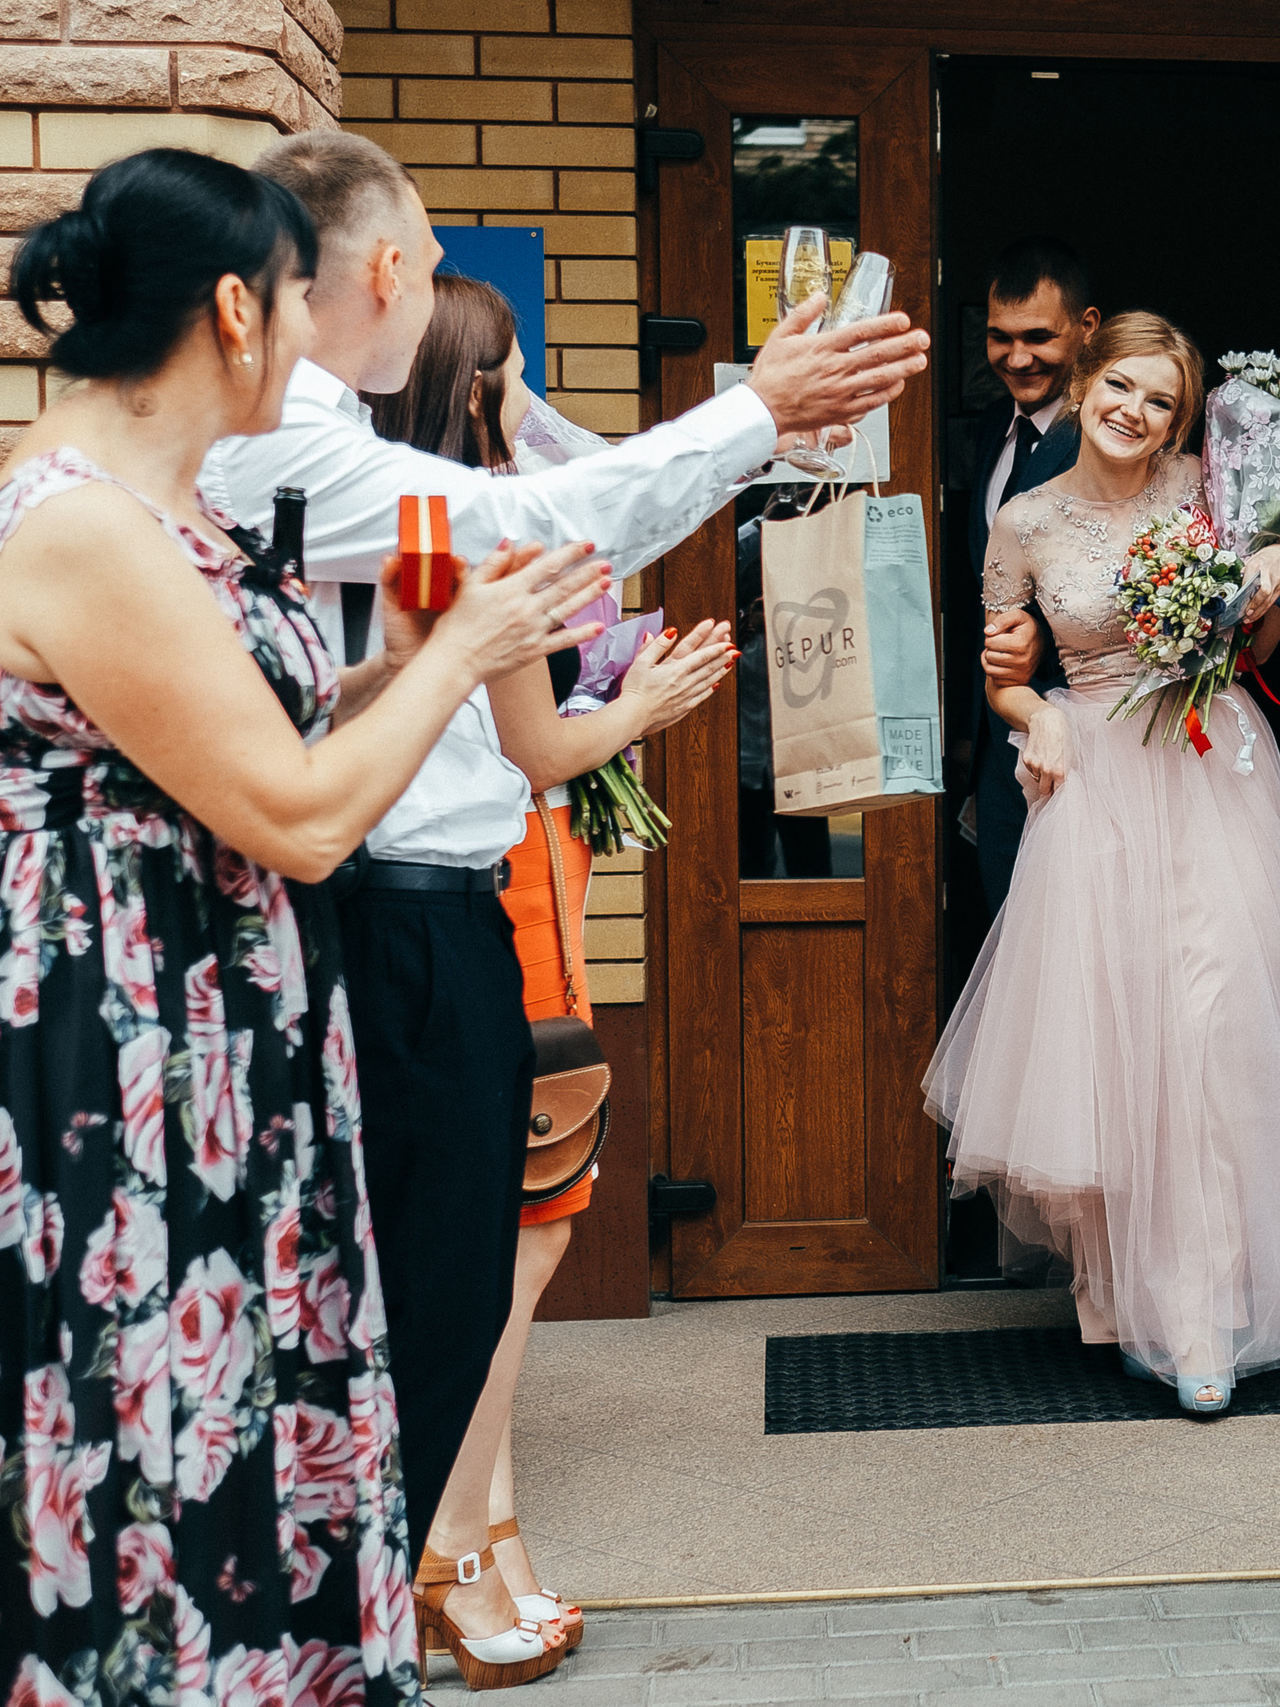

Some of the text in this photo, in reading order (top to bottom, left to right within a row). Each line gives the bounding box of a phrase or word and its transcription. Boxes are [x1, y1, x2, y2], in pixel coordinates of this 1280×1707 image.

[888, 506, 913, 518] eco
[775, 627, 855, 669] GEPUR
[889, 729, 922, 740] MADE
[890, 744, 924, 755] WITH
